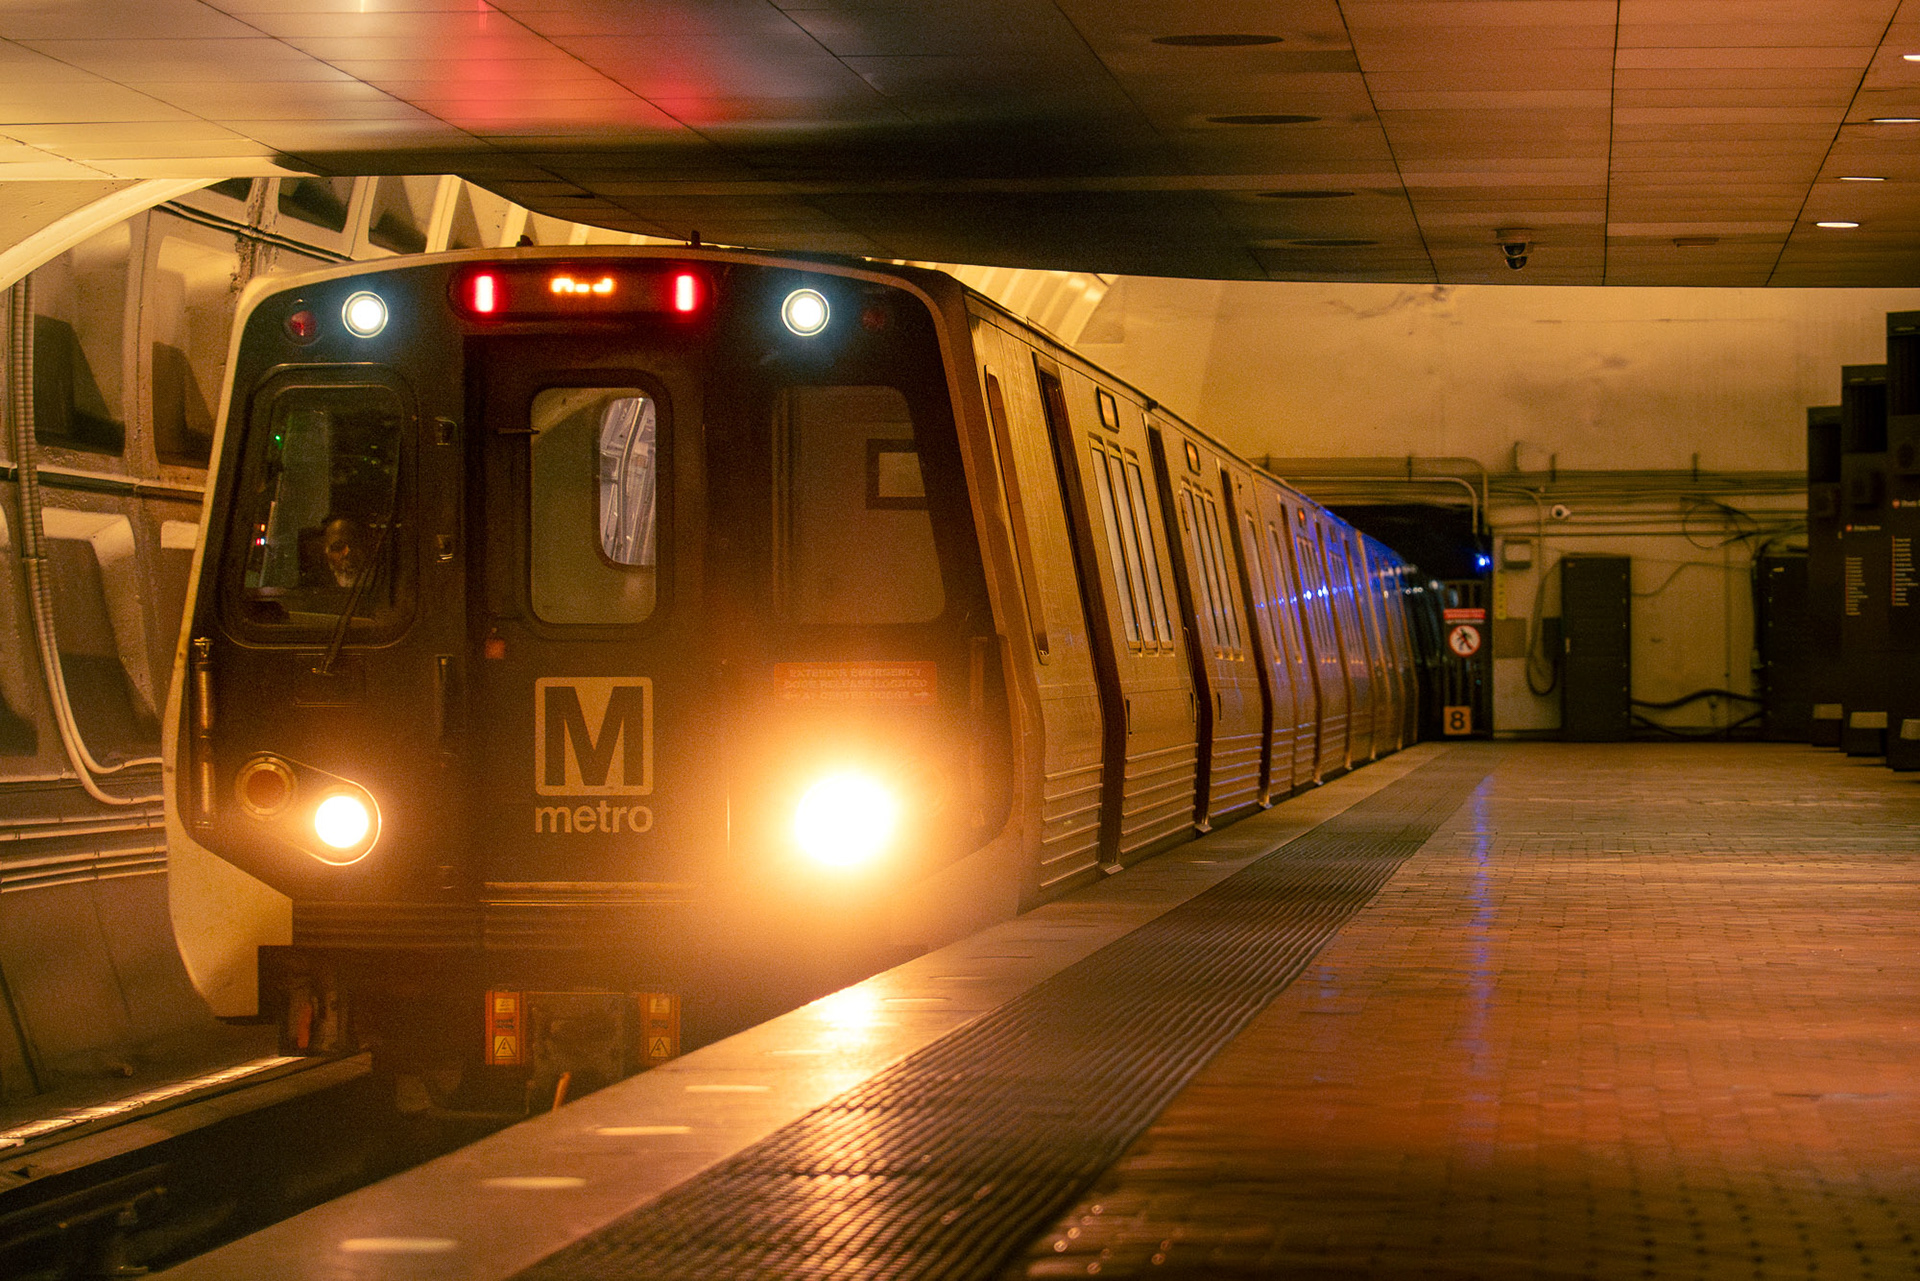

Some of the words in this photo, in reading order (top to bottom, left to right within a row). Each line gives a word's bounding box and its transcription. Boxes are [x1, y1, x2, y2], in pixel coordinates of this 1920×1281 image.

[789, 668, 847, 678] EXTERIOR
[850, 668, 922, 677] EMERGENCY
[1450, 710, 1465, 730] 8
[544, 686, 644, 786] M
[535, 800, 653, 833] metro
